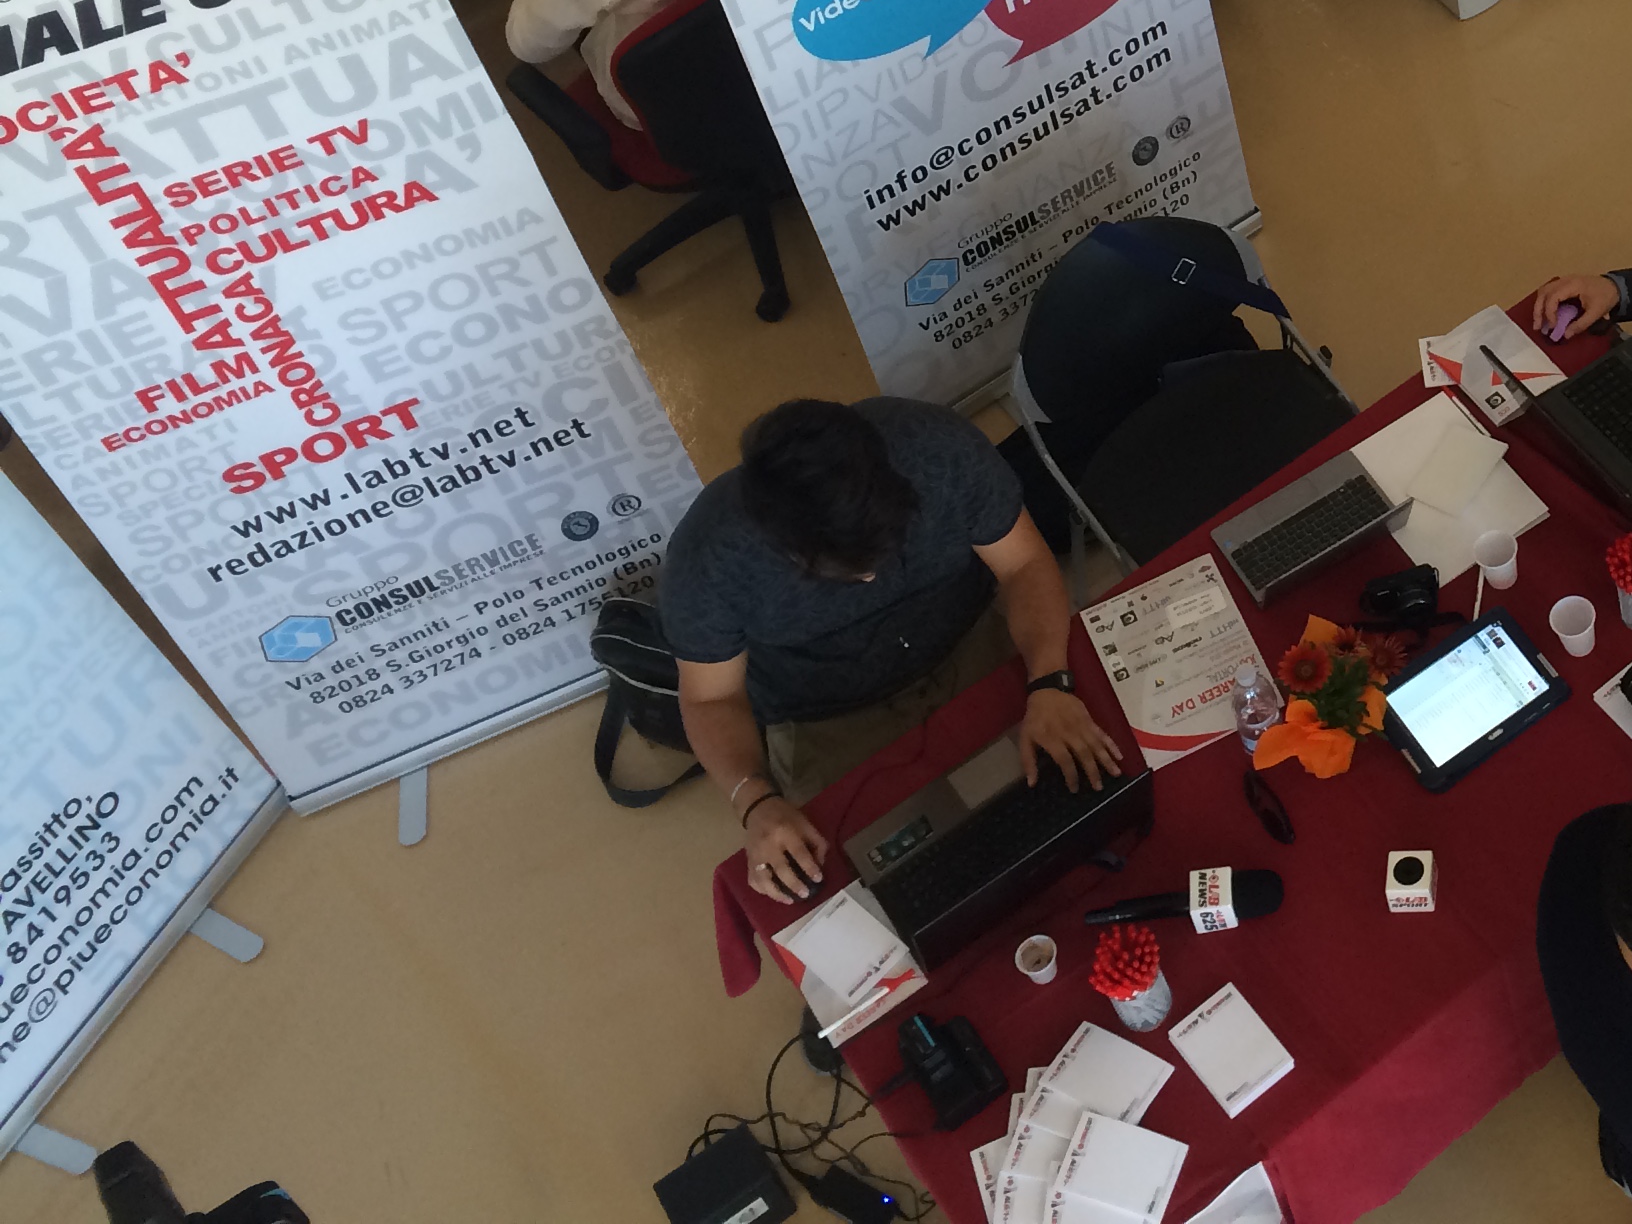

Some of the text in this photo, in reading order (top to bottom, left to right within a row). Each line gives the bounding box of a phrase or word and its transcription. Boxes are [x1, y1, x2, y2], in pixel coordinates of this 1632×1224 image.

[162, 117, 370, 208] SERIE TV
[863, 20, 1169, 211] info@consulsat.com
[876, 46, 1172, 233] www.consulsat.com
[179, 165, 380, 247] POLITICA
[204, 179, 440, 275] CULTURA
[918, 151, 1201, 332] Via dei Sanniti Polo Tecnologico
[957, 211, 1013, 251] Gruppo
[933, 303, 988, 343] 82018
[991, 256, 1062, 305] S.Giorgi
[1162, 170, 1198, 201] (Bn)
[133, 351, 261, 413] FILM
[221, 270, 342, 427] CRONACA
[951, 317, 995, 350] 0824
[100, 380, 276, 453] ECONOMIA
[222, 397, 421, 495] SPORT
[206, 417, 592, 583] redazione@labtv.net
[230, 405, 536, 539] www.labtv.net
[285, 532, 663, 692] Via dei Sanniti Polo Tecnologico
[309, 551, 663, 705] 82018 S.Giorgio del Sannio (Bn)
[326, 576, 399, 608] Gruppo
[335, 533, 544, 626] CONSULSERVICE
[338, 682, 394, 714] 0824
[399, 646, 482, 690] 337274
[502, 616, 557, 646] 0824
[1170, 676, 1237, 719] AREER DAY
[0, 794, 94, 904] assitto,
[2, 790, 120, 936] AVELLINO
[6, 831, 121, 965] 8419533
[1198, 871, 1208, 908] NEWS
[1200, 911, 1219, 931] 625
